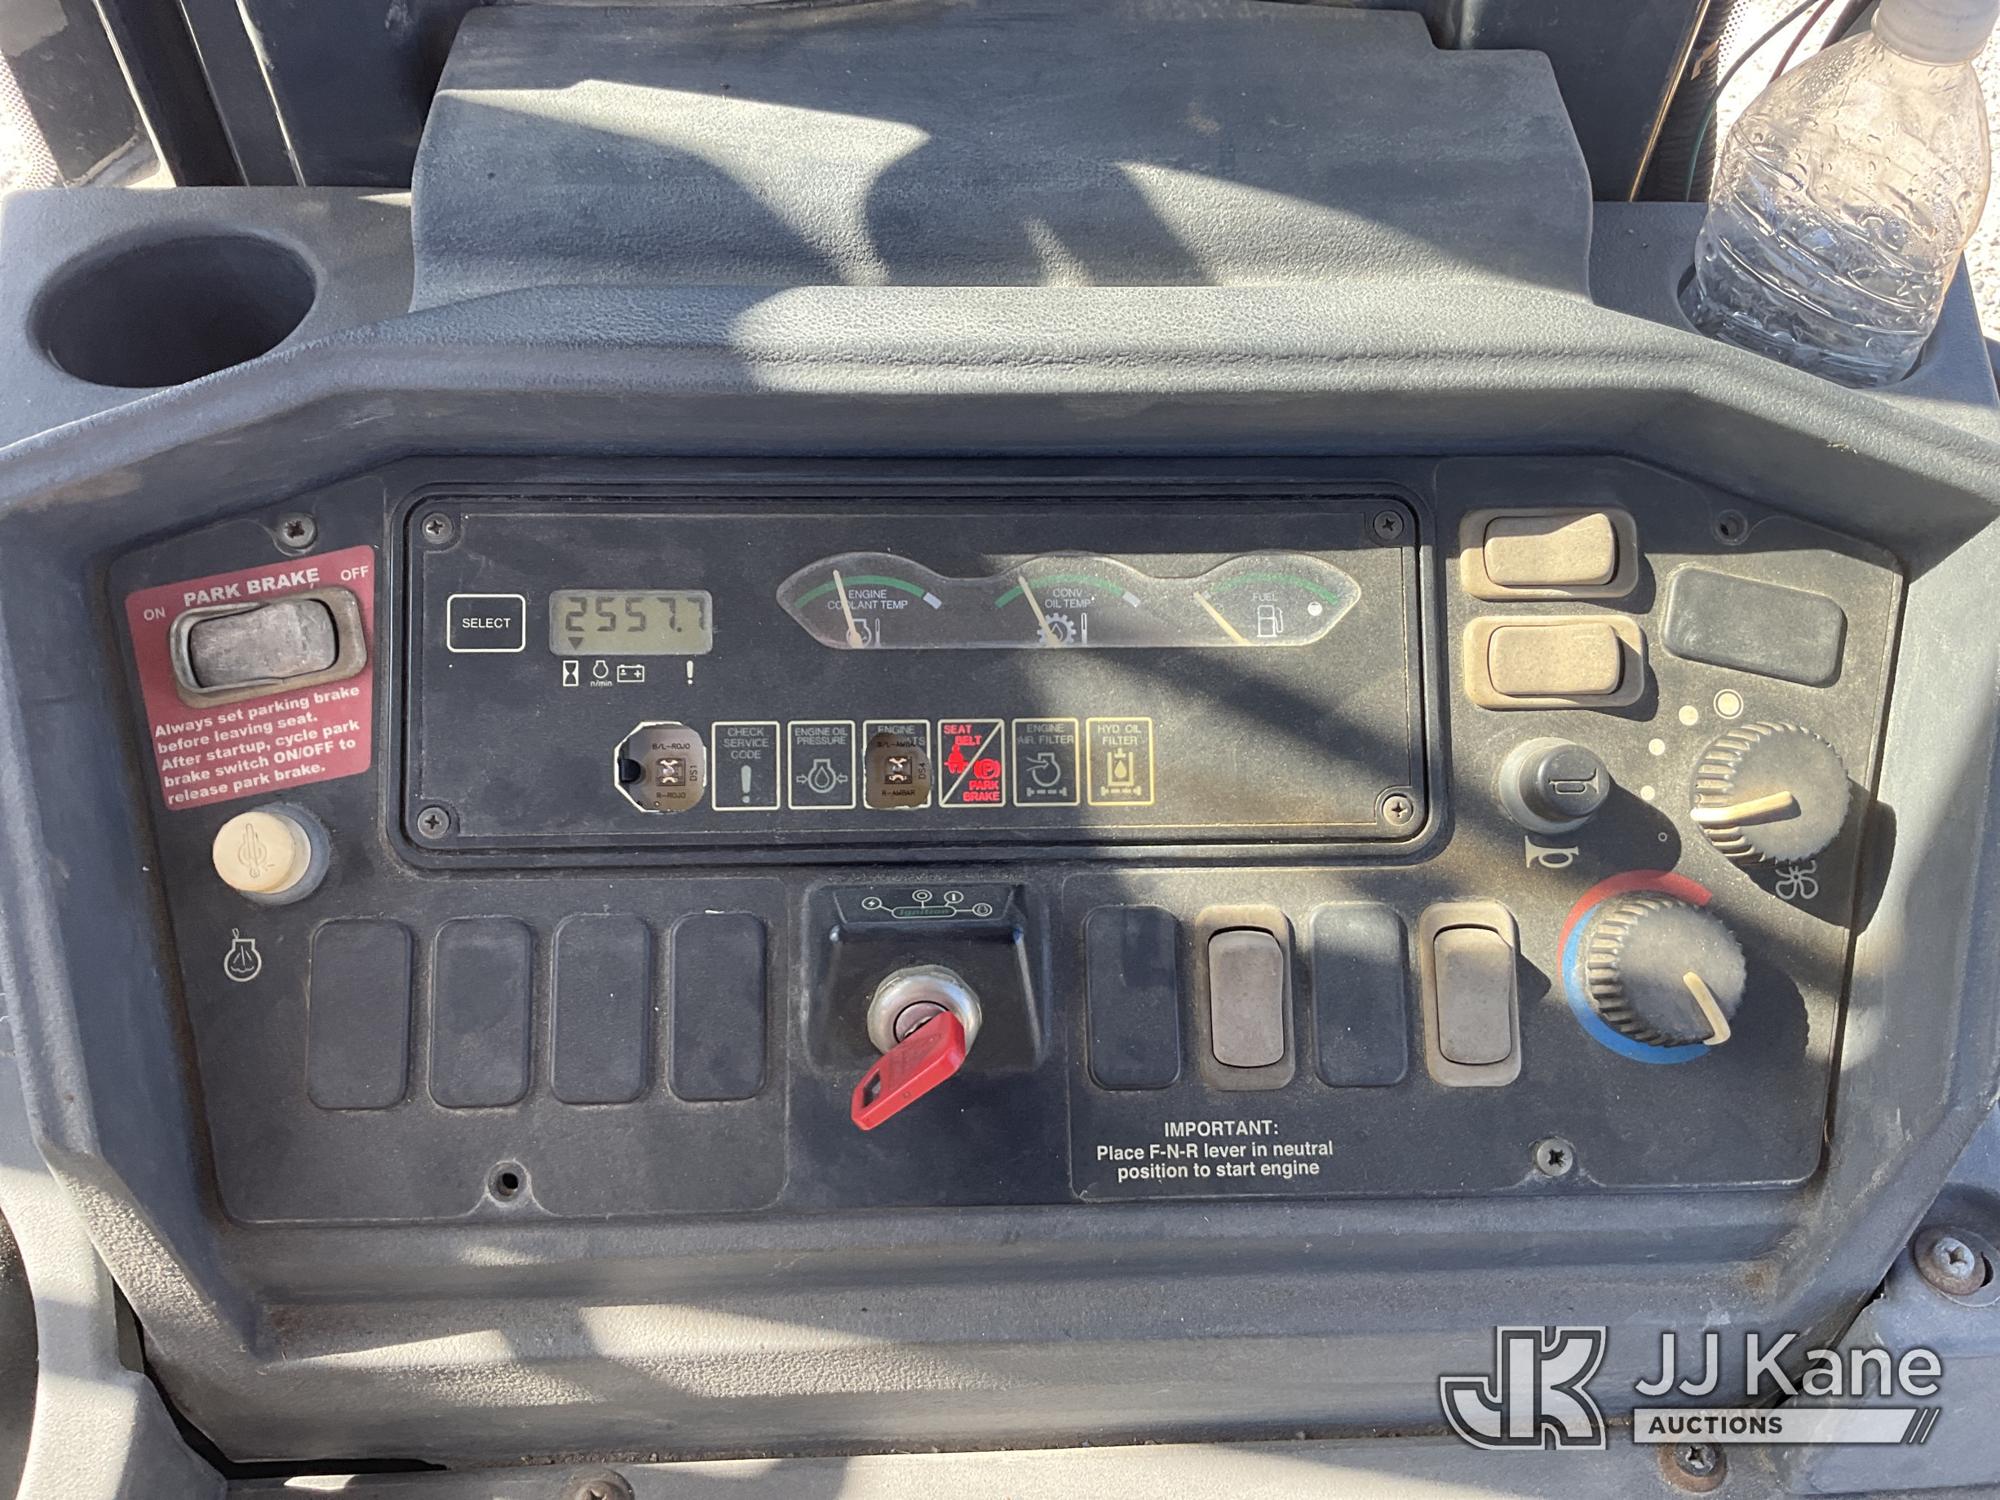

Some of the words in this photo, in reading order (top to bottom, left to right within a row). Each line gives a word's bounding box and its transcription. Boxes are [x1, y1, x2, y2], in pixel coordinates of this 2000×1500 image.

[340, 566, 369, 581] OFF
[183, 583, 241, 607] PARK
[246, 568, 320, 594] BRAKE
[1053, 588, 1082, 597] CONV
[848, 589, 887, 599] ENGINE
[1252, 593, 1278, 601] FUEL
[880, 600, 908, 609] TEMP
[1045, 599, 1061, 608] OIL
[1064, 599, 1091, 608] TEMP
[143, 607, 166, 621] ON
[565, 597, 705, 632] 2557.7
[462, 618, 511, 629] SELECT
[155, 717, 213, 737] Always
[218, 709, 243, 724] set
[248, 697, 310, 720] parking
[314, 687, 360, 704] brake
[157, 735, 210, 753] before
[214, 722, 273, 742] leaving
[278, 711, 318, 728] seat.
[727, 728, 765, 737] CHECK
[795, 727, 831, 736] ENGINE
[832, 727, 848, 736] OIL
[944, 724, 972, 734] SEAT
[1027, 723, 1065, 733] ENGINE
[1097, 724, 1119, 733] HYD
[1125, 724, 1141, 733] OIL
[723, 738, 769, 748] SERVICE
[797, 736, 846, 745] PRESSURE
[955, 735, 982, 746] BELT
[1039, 735, 1074, 744] FILTER
[1103, 735, 1138, 745] FILTER
[161, 755, 201, 771] After
[207, 741, 271, 761] startup,
[275, 728, 318, 747] cycle
[322, 719, 360, 739] park
[731, 750, 761, 759] CODE
[164, 770, 210, 788] brake
[215, 756, 269, 776] switch
[273, 741, 334, 764] ON/OFF
[339, 738, 356, 750] to
[689, 765, 698, 781] DS1
[168, 783, 228, 804] release
[233, 773, 270, 793] park
[274, 763, 326, 781] brake.
[969, 780, 999, 790] PARK
[963, 791, 1000, 802] BRAKE
[1164, 1120, 1279, 1137] IMPORTANT:
[1096, 1145, 1144, 1160] Place
[1150, 1143, 1198, 1159] F-N-R
[1204, 1142, 1246, 1158] lever
[1251, 1142, 1267, 1156] in
[1273, 1140, 1333, 1156] neutral
[1117, 1163, 1188, 1182] position
[1193, 1163, 1210, 1177] to
[1216, 1161, 1256, 1177] start
[1260, 1160, 1320, 1179] engine
